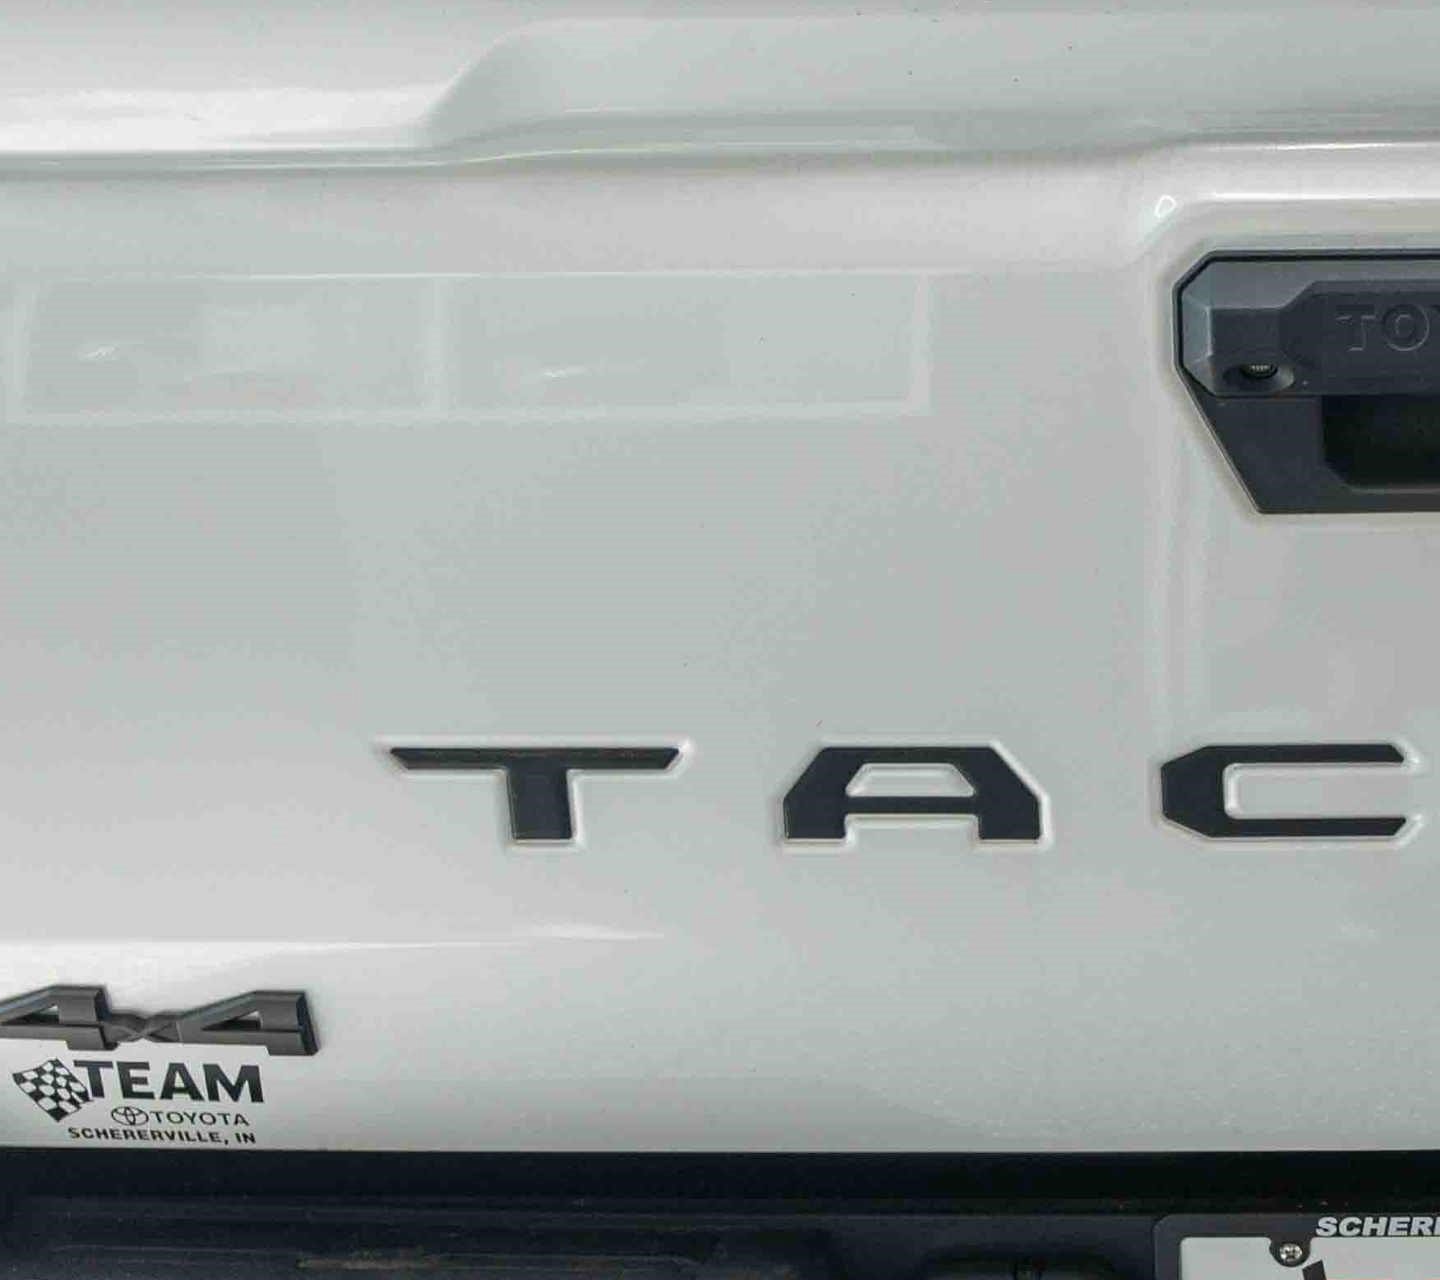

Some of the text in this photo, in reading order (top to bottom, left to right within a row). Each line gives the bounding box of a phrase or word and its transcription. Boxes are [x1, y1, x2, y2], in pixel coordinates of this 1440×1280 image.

[73, 1060, 264, 1103] TEAM
[149, 1110, 250, 1125] TOYOTA
[67, 1126, 256, 1145] SCHERERVILLE, IN
